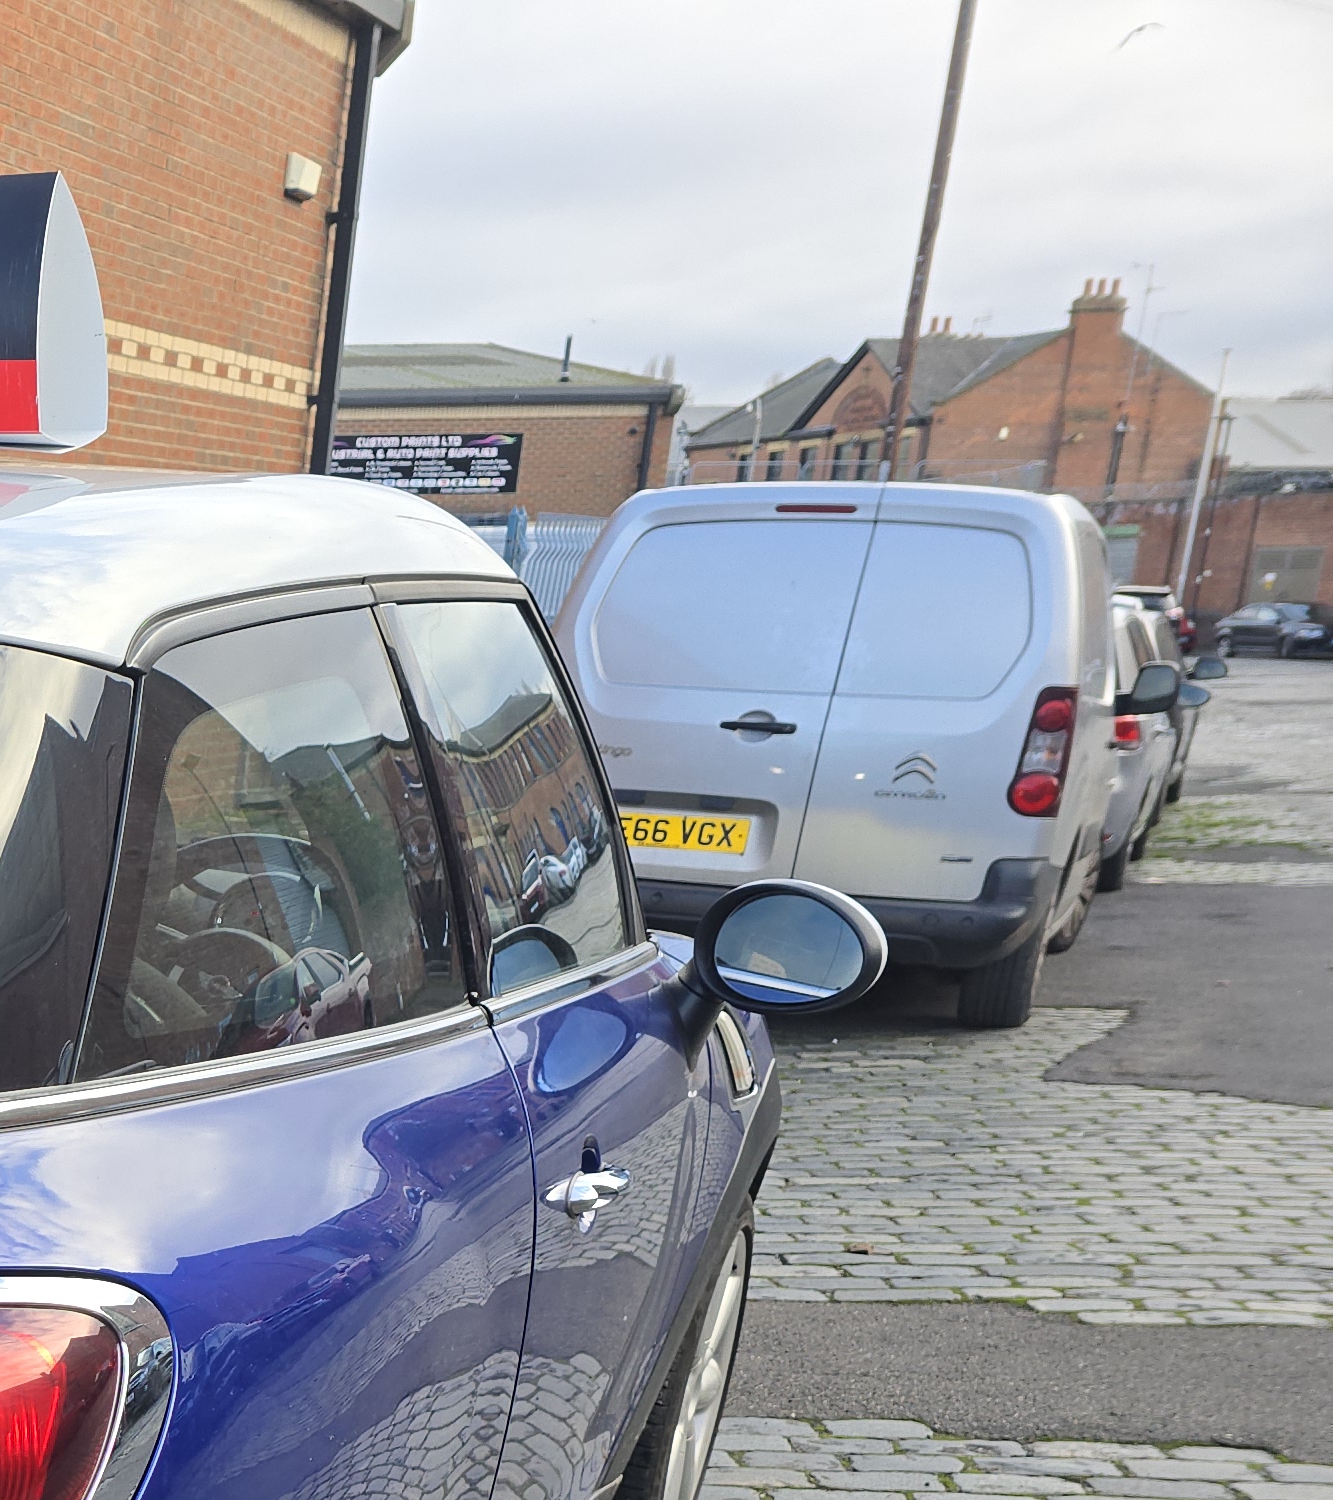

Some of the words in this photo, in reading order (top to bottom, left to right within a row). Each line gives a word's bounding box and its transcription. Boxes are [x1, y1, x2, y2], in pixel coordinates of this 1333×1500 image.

[355, 436, 400, 448] CUSTOM
[332, 448, 375, 459] USTRIAL
[386, 448, 414, 459] AUTO
[682, 816, 737, 848] VGX
